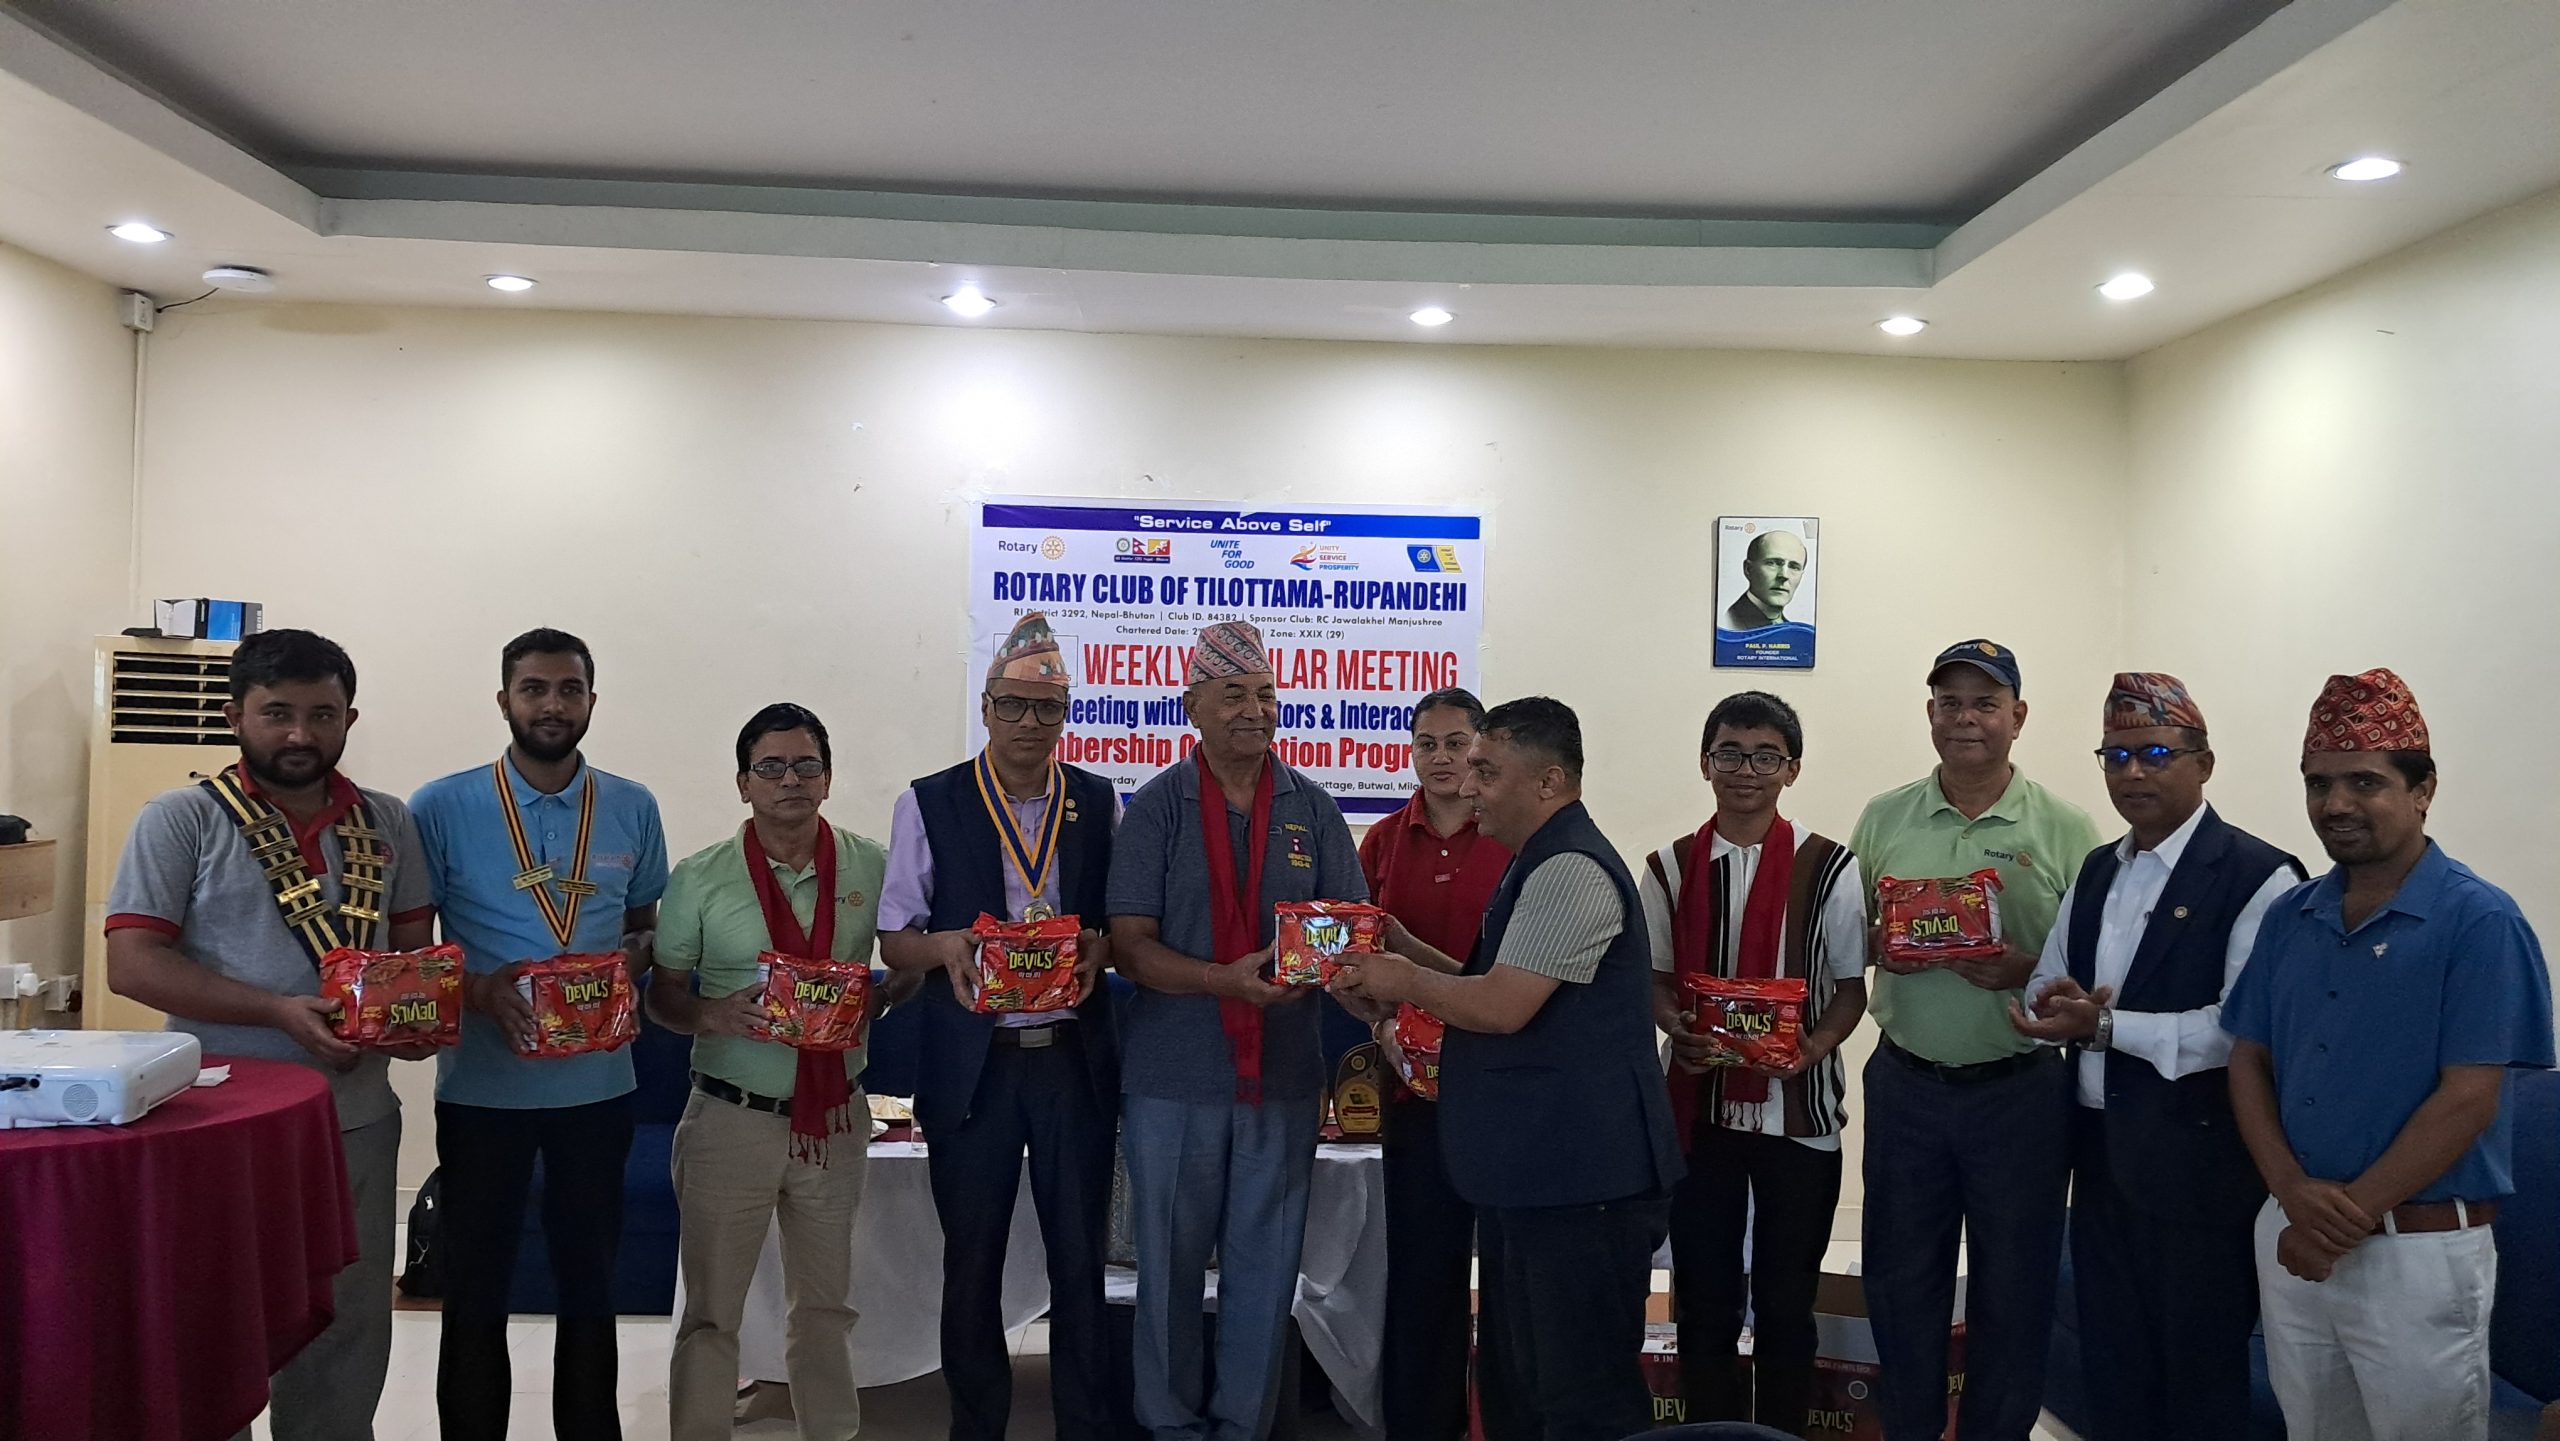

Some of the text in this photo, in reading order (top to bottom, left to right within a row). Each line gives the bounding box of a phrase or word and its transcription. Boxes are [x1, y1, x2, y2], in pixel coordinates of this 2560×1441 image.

[1134, 515, 1332, 532] "Service Above Self"
[998, 540, 1038, 554] Rotary
[1210, 539, 1240, 549] UNITE
[1221, 549, 1242, 559] FOR
[1224, 559, 1255, 569] GOOD
[993, 571, 1467, 612] ROTARY CLUB OF TILOTTAMA-RUPANDEHI
[1014, 607, 1023, 616] RI
[1061, 609, 1088, 619] 3292,
[1091, 610, 1155, 621] Nepal-Bhutan
[1168, 612, 1189, 620] Club
[1192, 612, 1204, 621] ID.
[1207, 613, 1237, 621] 84382
[1249, 614, 1287, 625] Sponsor
[1290, 615, 1313, 624] Club:
[1316, 616, 1329, 624] RC
[1332, 616, 1385, 625] Jawalakhel
[1388, 617, 1443, 627] Manjushree
[1116, 625, 1161, 635] Chartered
[1164, 626, 1190, 635] Date:
[1270, 629, 1296, 638] Zone:
[1299, 630, 1323, 638] XXIX
[1326, 630, 1345, 640] (29)
[1084, 643, 1196, 687] WEEKLY
[1337, 649, 1458, 692] MEETING
[1143, 696, 1188, 726] with
[1320, 703, 1335, 730] &
[1340, 699, 1413, 731] Interac
[1339, 736, 1413, 774] Progr
[1358, 781, 1395, 791] Butwal,
[1984, 848, 2014, 862] Rotary
[1912, 914, 1960, 938] DEVIL'S
[1009, 950, 1053, 970] DEVIL'S
[565, 979, 609, 1004] DEVIL'S
[794, 981, 839, 1004] DEVIL'S
[390, 1000, 437, 1025] DEVIL'S
[1726, 1012, 1772, 1033] DEVIL'S
[1653, 1396, 1686, 1423] DEV
